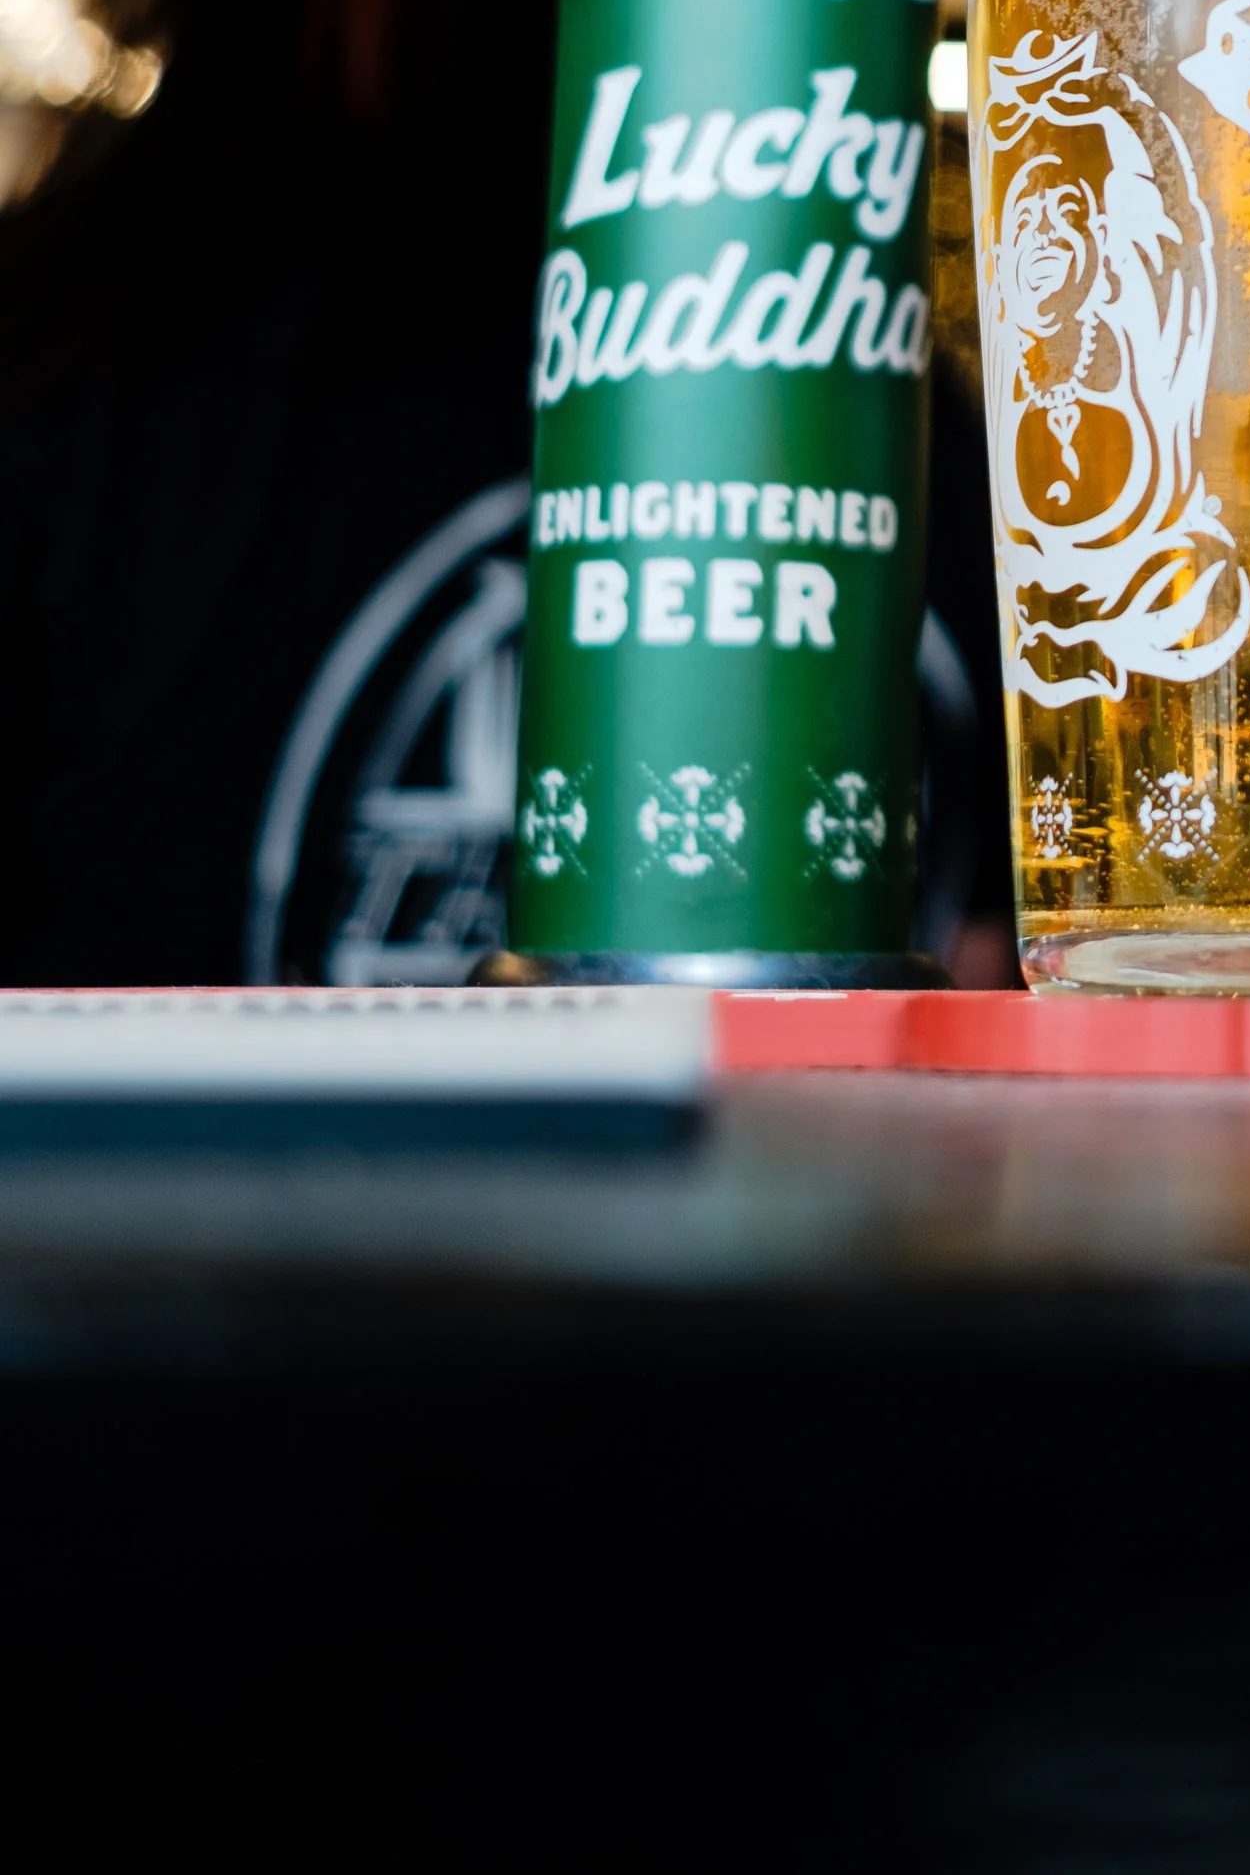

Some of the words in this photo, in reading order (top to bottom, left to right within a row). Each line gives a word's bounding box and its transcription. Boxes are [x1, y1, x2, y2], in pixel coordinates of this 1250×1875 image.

[561, 64, 926, 243] Lucky
[531, 240, 932, 411] Buddha
[536, 480, 899, 553] ENLIGHTENED
[570, 556, 838, 650] BEER
